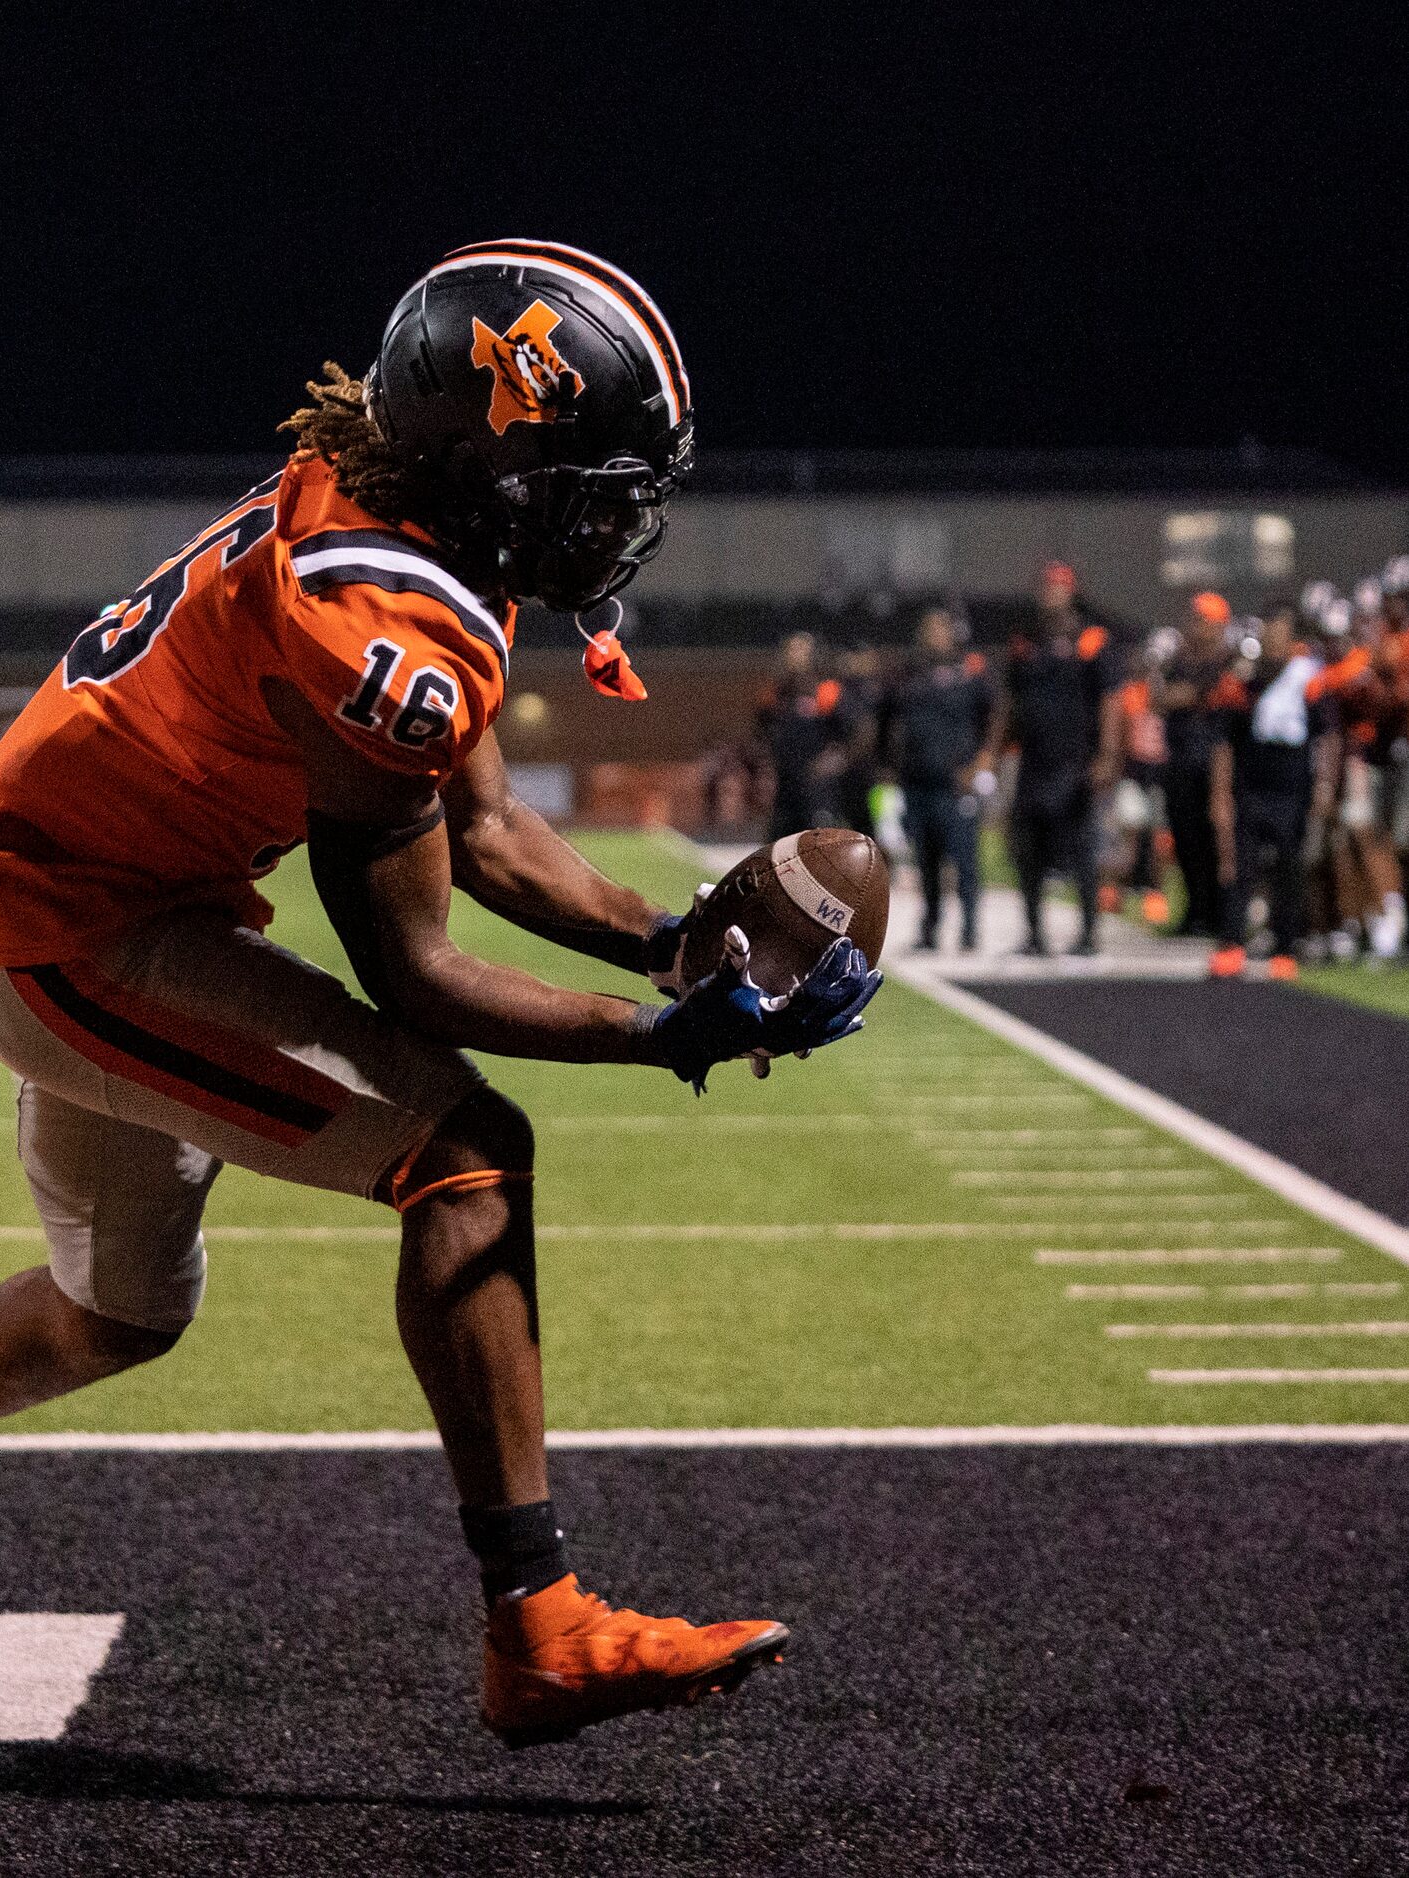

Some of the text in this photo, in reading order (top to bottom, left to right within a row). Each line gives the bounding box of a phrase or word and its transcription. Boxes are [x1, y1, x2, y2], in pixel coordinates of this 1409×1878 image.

[62, 470, 288, 691] 6
[334, 636, 460, 751] 16
[816, 898, 846, 929] WR
